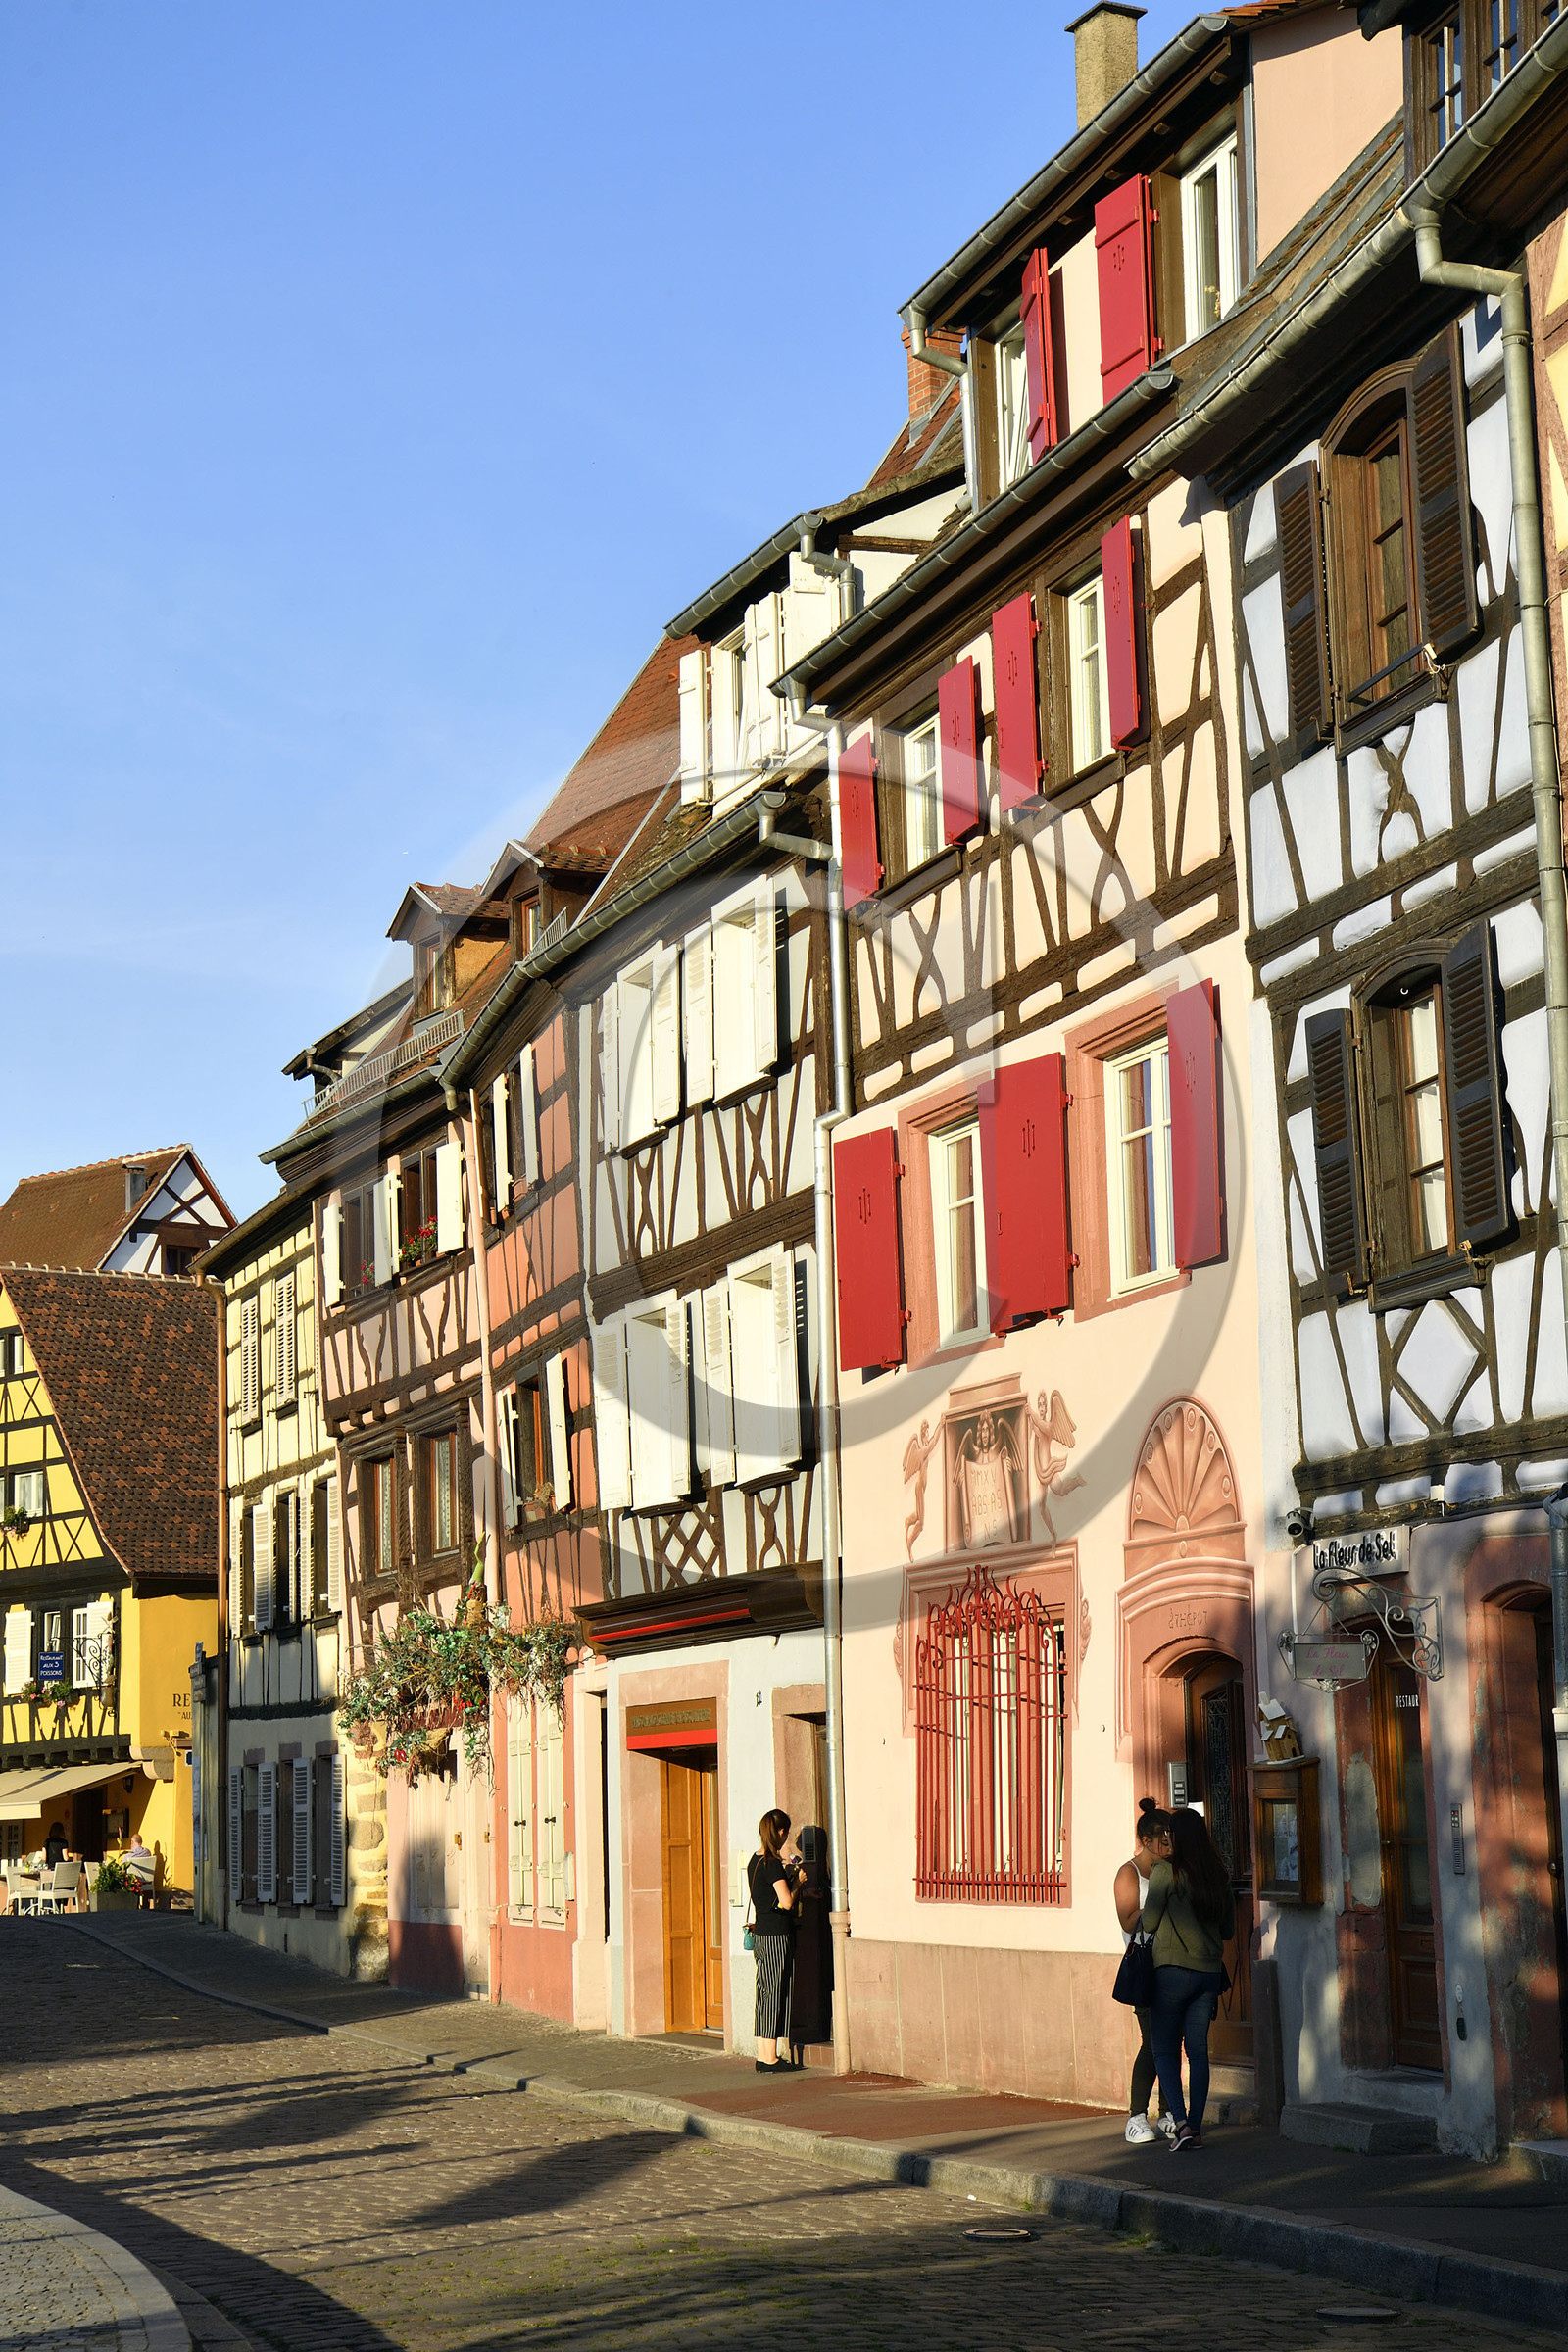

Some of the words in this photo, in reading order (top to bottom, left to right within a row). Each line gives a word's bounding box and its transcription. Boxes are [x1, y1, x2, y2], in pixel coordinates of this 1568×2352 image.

[1313, 1544, 1325, 1570] La
[1359, 1535, 1373, 1563] de
[1376, 1531, 1396, 1562] Sel
[1306, 1647, 1319, 1659] La
[1324, 1646, 1349, 1659] Fleur
[1313, 1664, 1324, 1677] de
[1329, 1664, 1345, 1677] Sel
